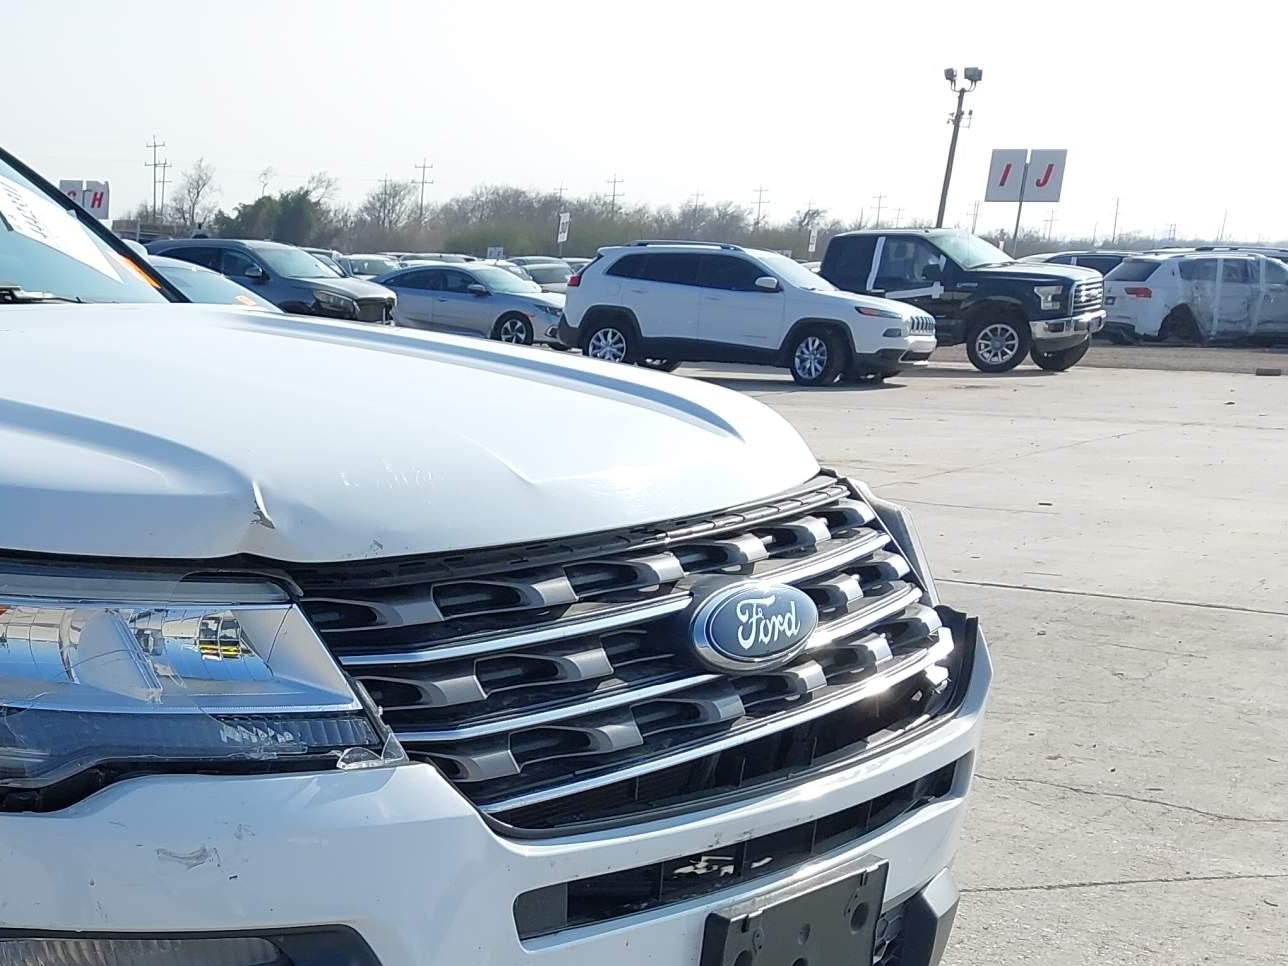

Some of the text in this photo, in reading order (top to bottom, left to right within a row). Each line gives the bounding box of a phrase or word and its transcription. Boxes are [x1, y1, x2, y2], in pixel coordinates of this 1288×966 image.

[999, 163, 1012, 187] I
[1035, 163, 1054, 188] J
[90, 191, 104, 208] H
[736, 594, 801, 650] Ford
